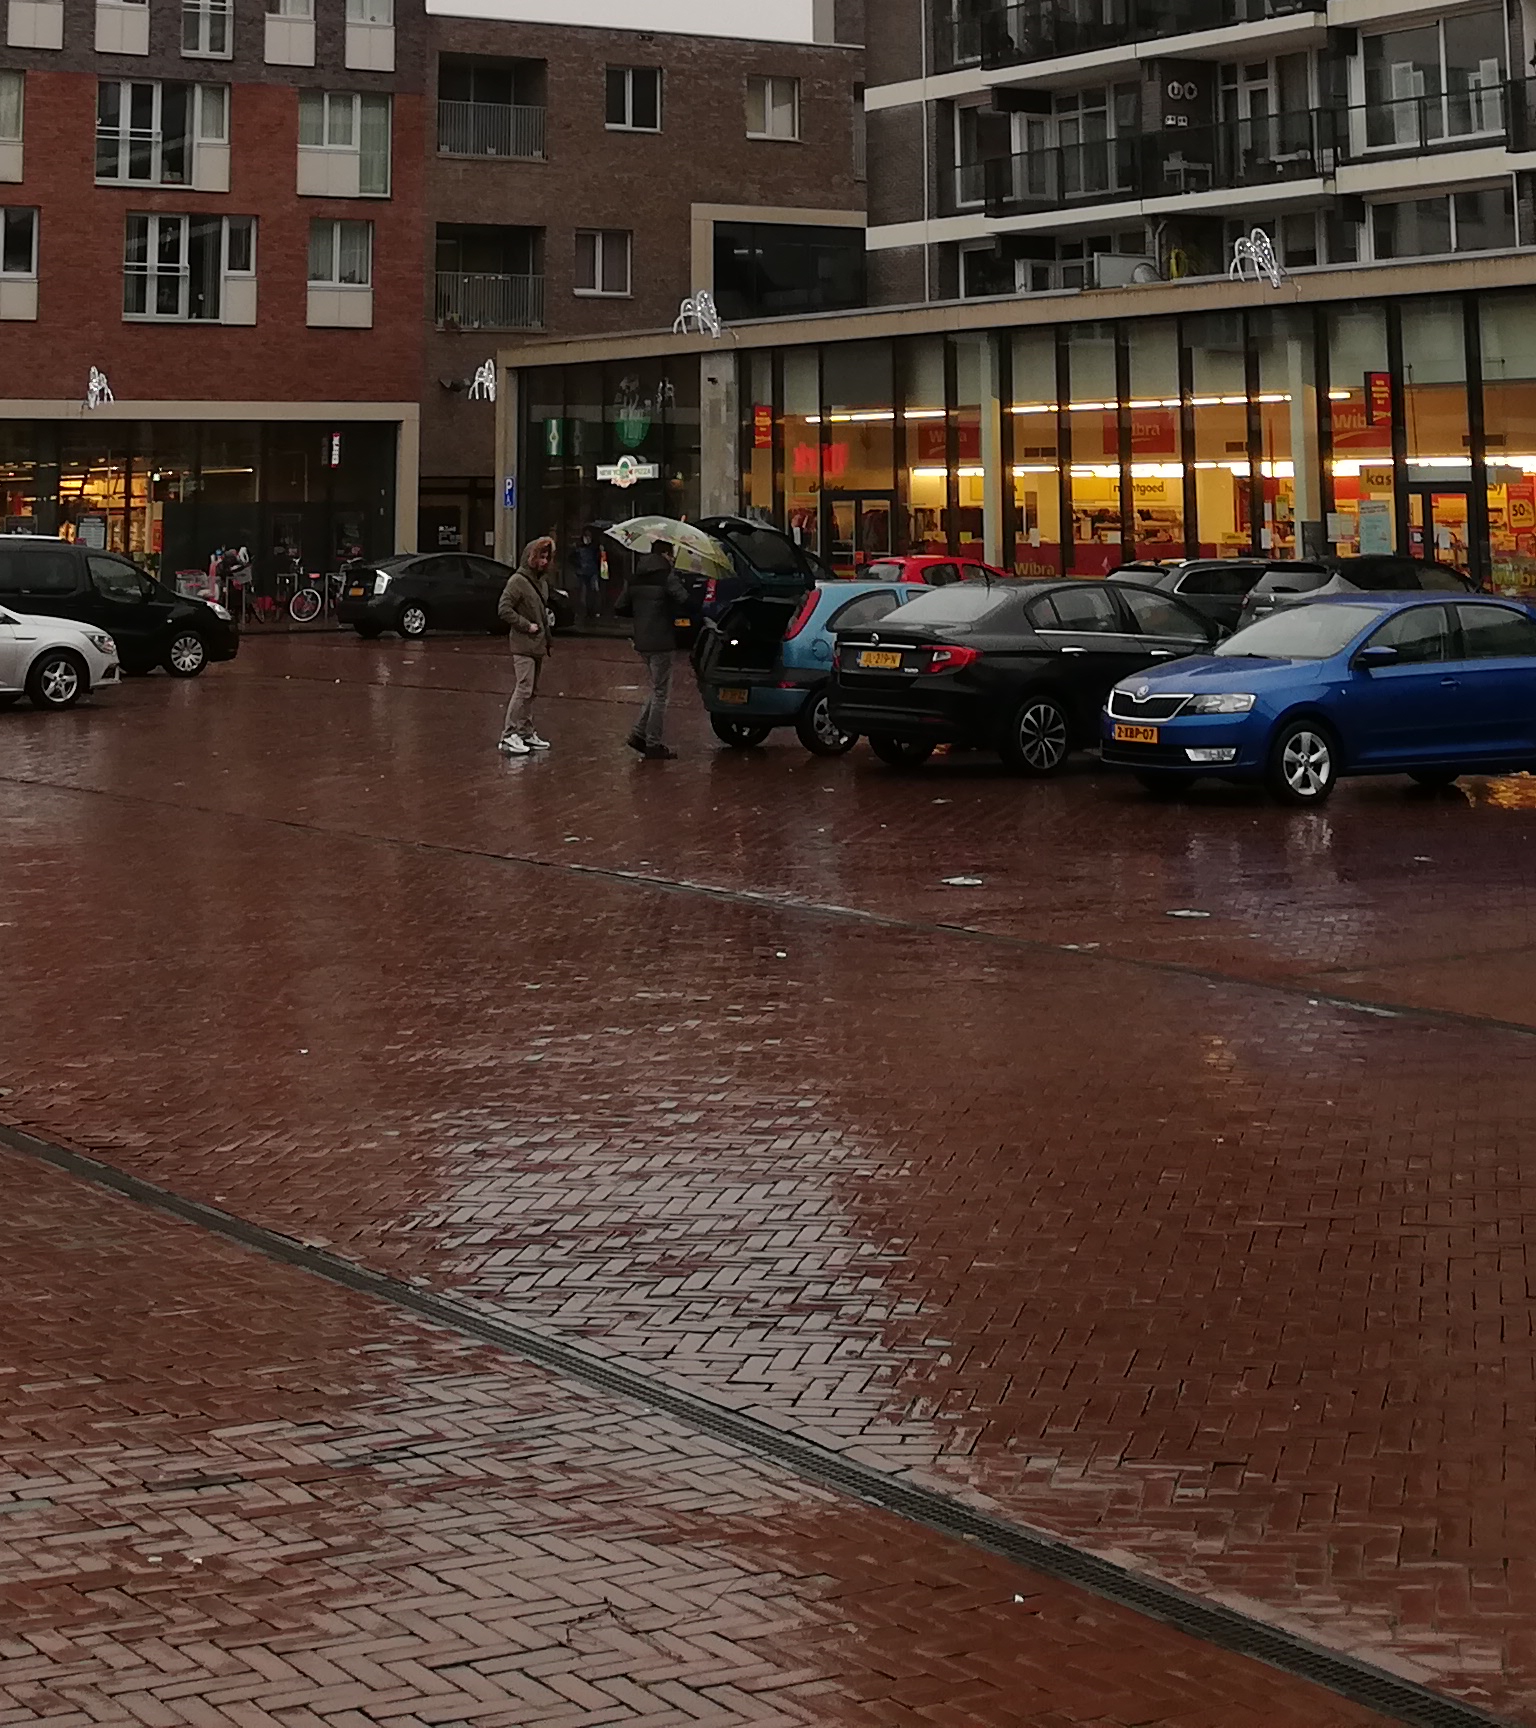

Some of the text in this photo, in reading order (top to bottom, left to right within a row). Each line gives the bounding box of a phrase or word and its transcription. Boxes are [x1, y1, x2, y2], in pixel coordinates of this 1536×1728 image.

[1366, 468, 1392, 486] kas
[505, 478, 513, 494] P
[1013, 561, 1055, 576] Wibra
